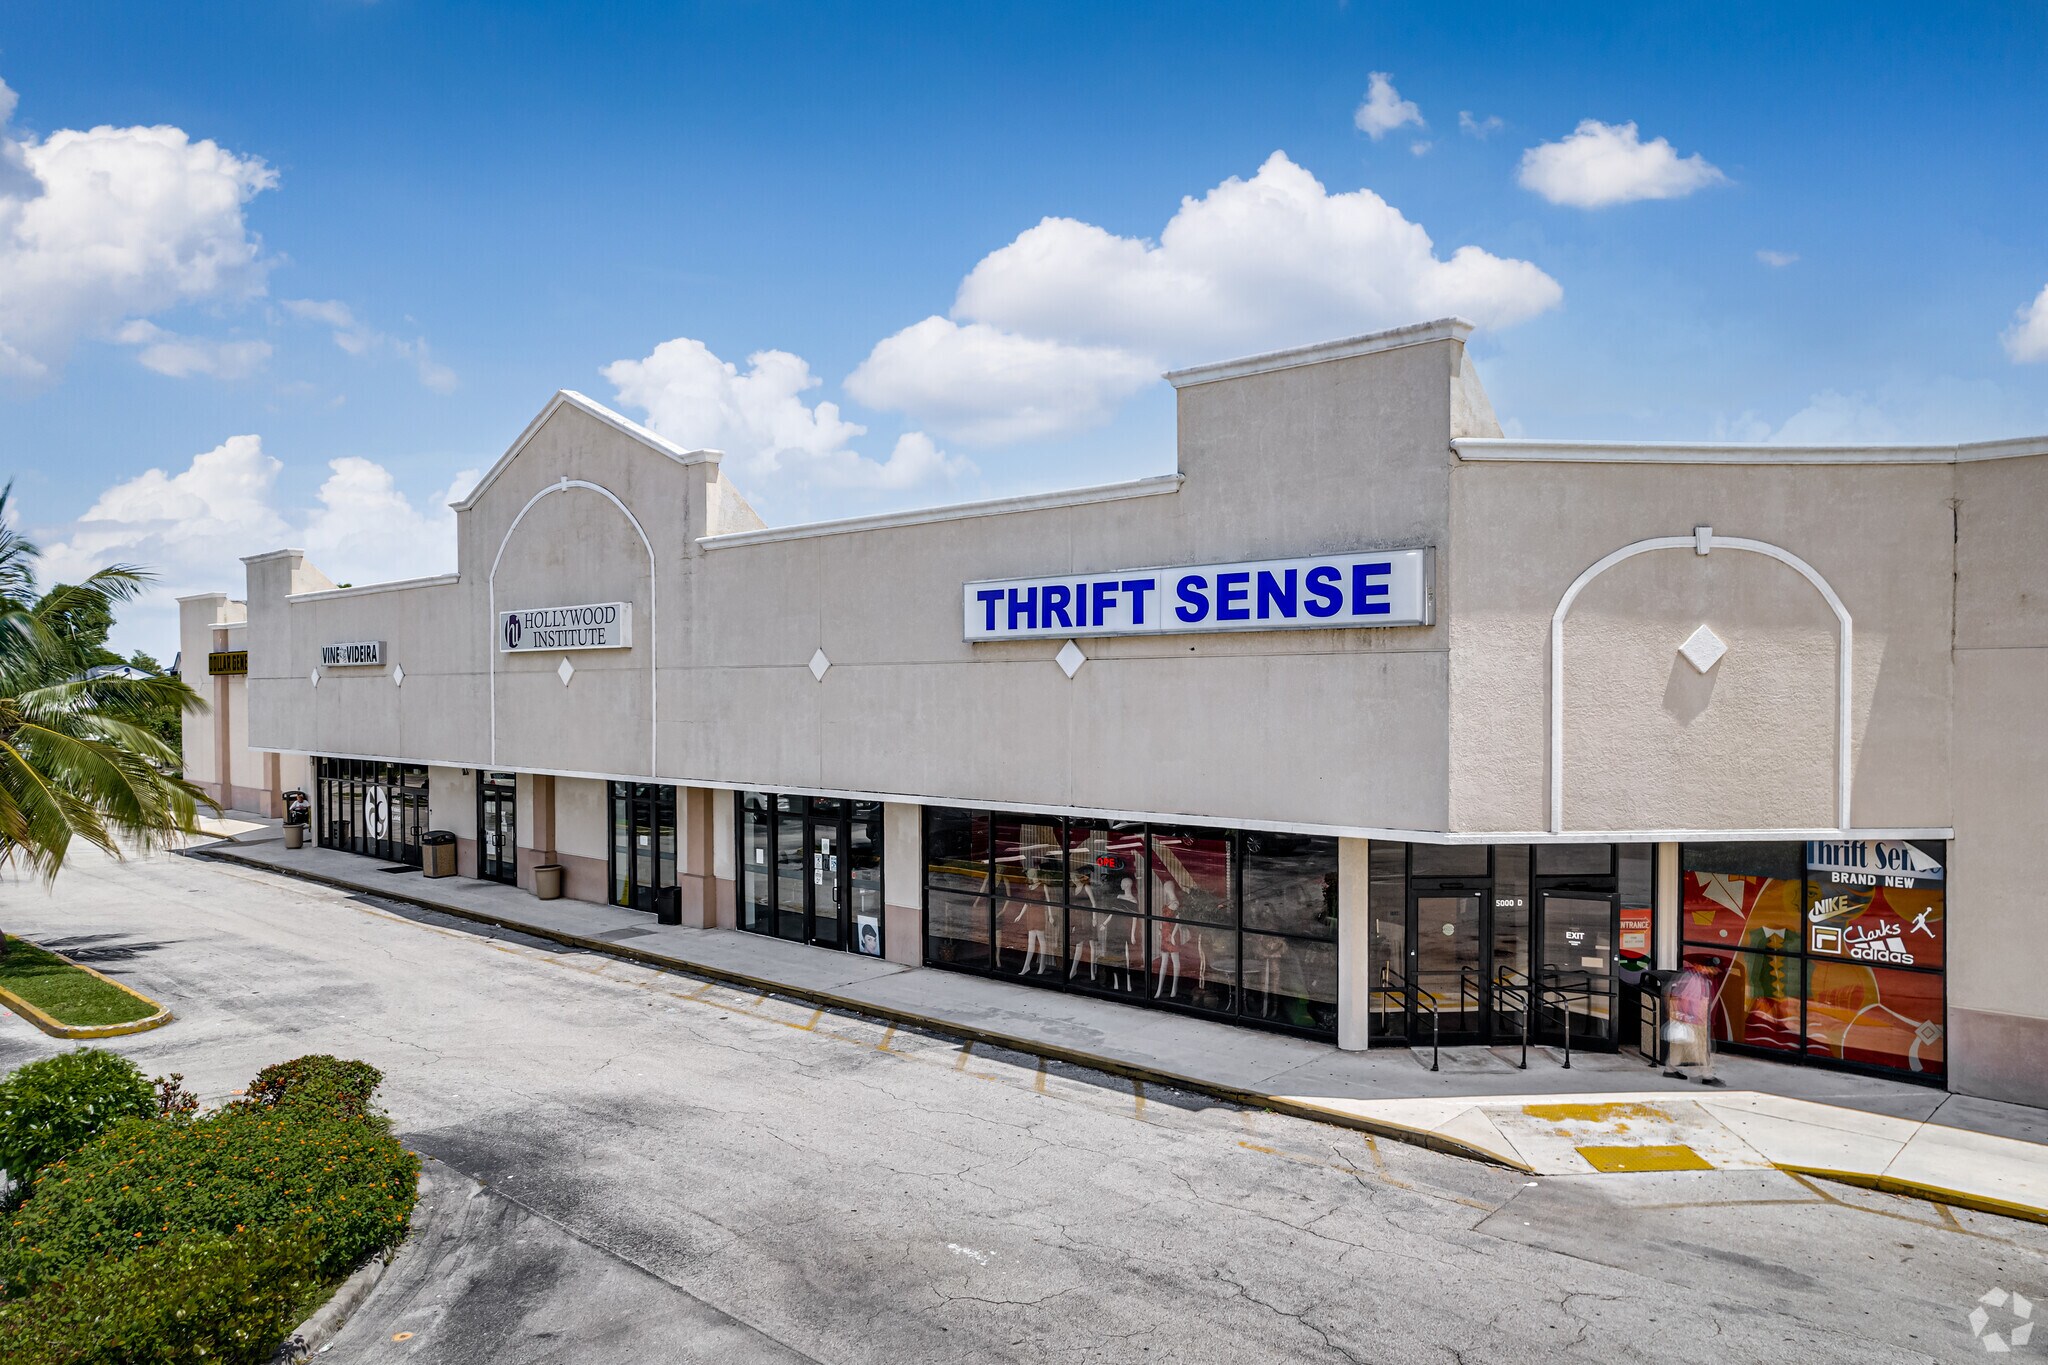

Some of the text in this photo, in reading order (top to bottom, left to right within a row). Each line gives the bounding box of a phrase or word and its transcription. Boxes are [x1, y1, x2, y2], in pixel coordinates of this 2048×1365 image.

[977, 562, 1392, 631] THRIFT SENSE
[524, 606, 616, 629] HOLLYWOOD
[533, 628, 607, 648] INSTITUTE
[322, 644, 378, 664] VINE VIDEIRA
[1831, 871, 1915, 889] BRAND NEW
[1814, 895, 1849, 915] NIKE
[1620, 921, 1649, 929] NTRANCE
[1843, 919, 1901, 943] Clarks
[1565, 931, 1585, 940] EXIT
[1850, 946, 1914, 965] adidas
